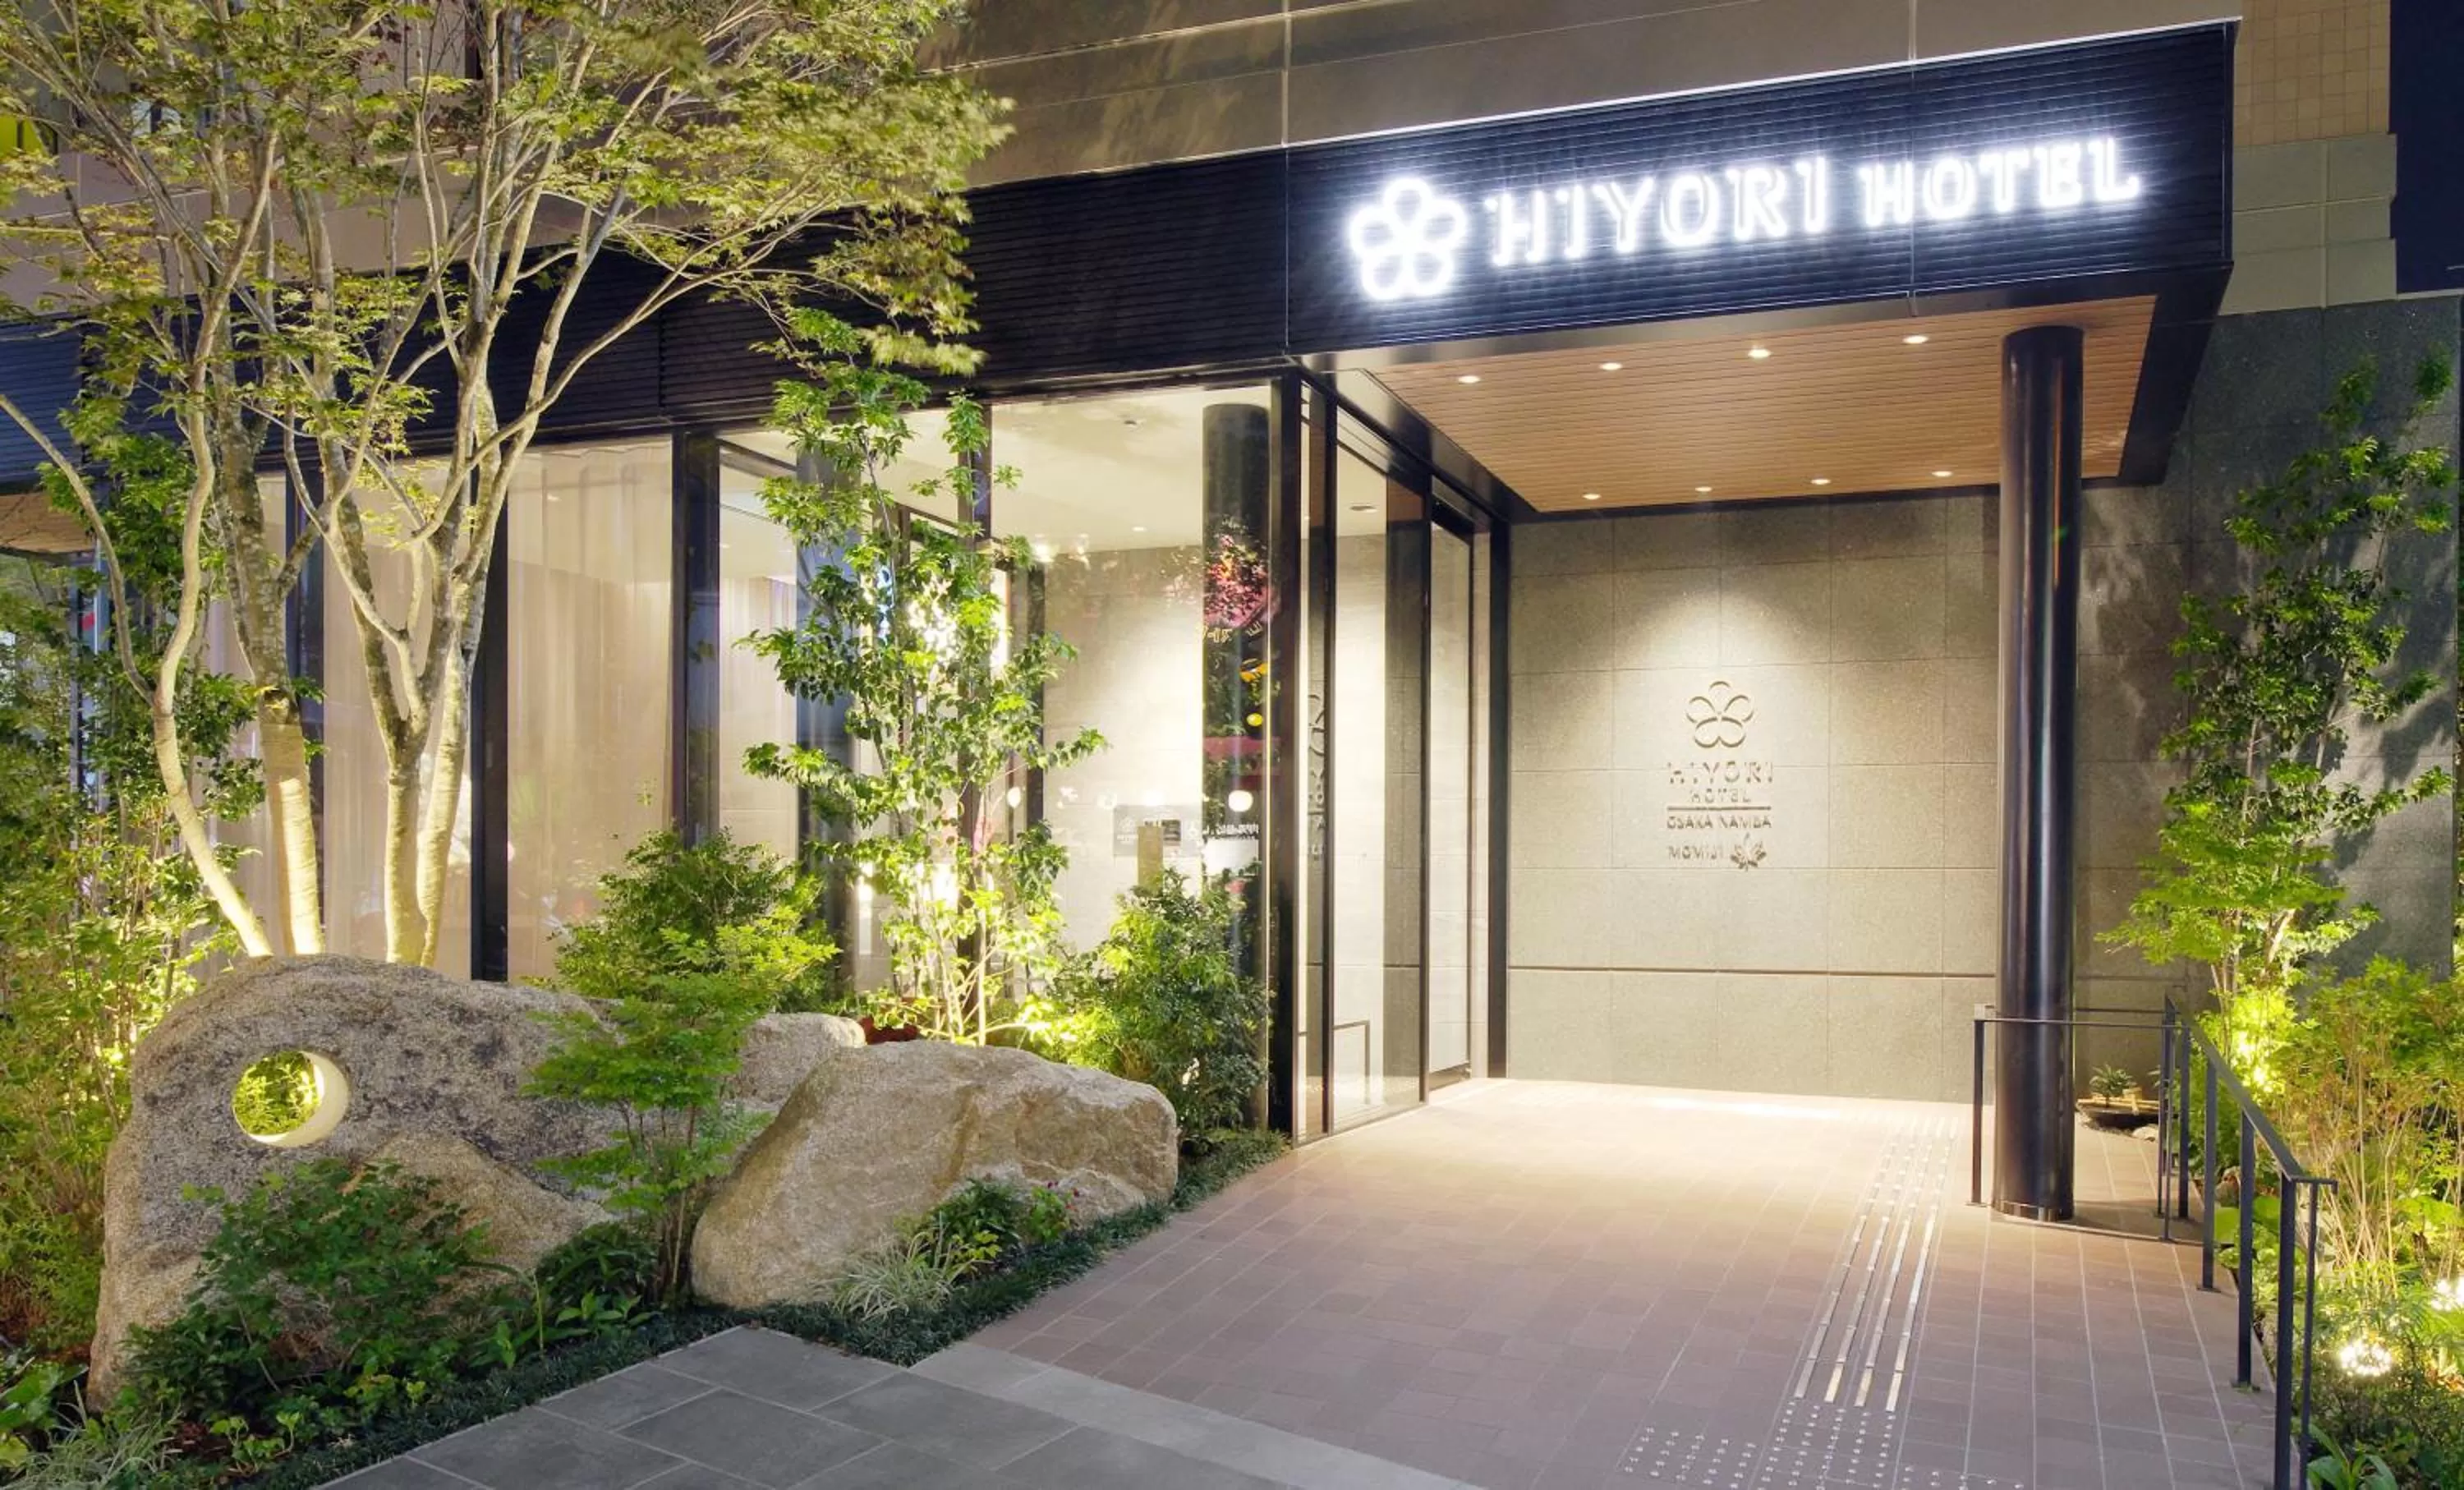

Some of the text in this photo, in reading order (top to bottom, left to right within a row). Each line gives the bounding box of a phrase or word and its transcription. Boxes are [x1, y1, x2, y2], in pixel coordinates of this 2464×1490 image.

[1484, 136, 2140, 267] HIYORI HOTEL
[1666, 760, 1773, 784] HIYORI
[1666, 815, 1713, 829] OSAKA
